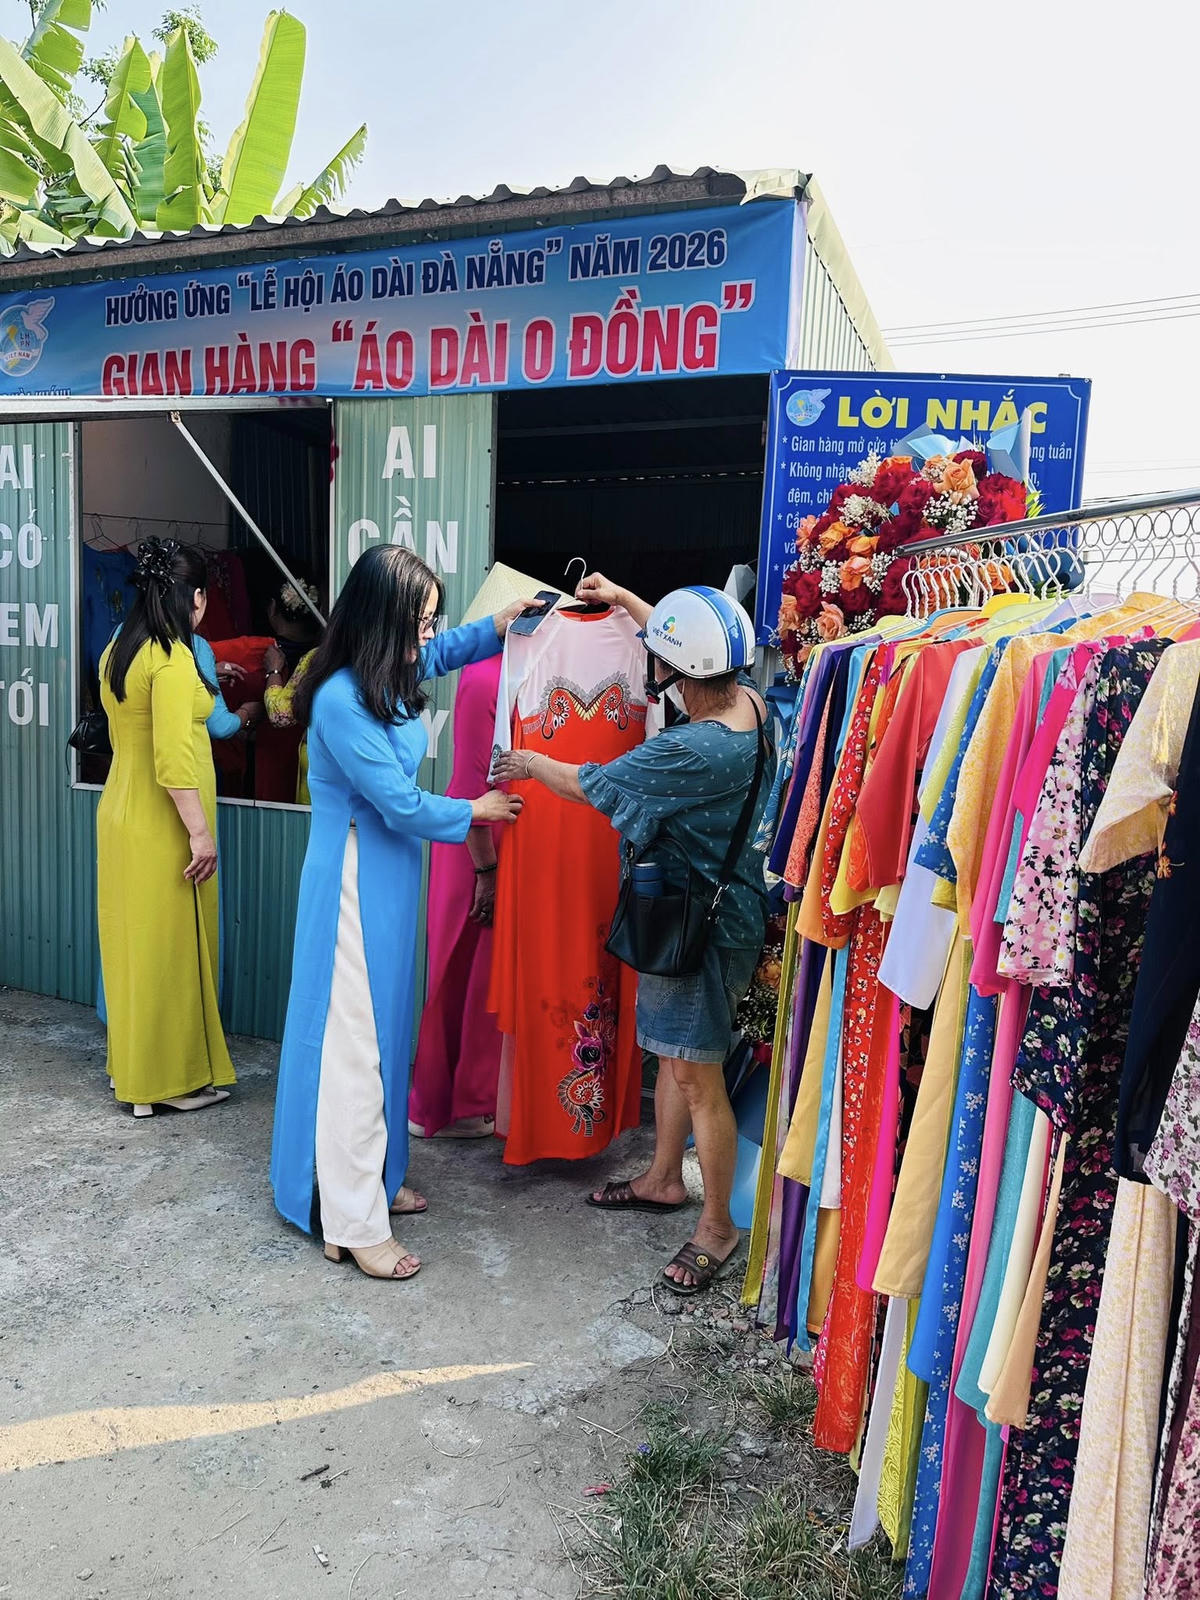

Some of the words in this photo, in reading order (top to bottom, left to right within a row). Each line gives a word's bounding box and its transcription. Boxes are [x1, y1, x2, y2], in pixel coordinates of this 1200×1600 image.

[105, 283, 179, 326] HƯỞNG
[183, 281, 231, 319] ỨNG
[283, 268, 324, 313] HỘI
[330, 264, 365, 303] ÁO
[371, 257, 415, 300] DÀI
[421, 251, 459, 295] ĐÀ
[569, 234, 641, 281] NĂM
[648, 230, 726, 272] 2026
[102, 348, 193, 396] GIAN
[204, 331, 316, 395] HÀNG
[430, 311, 508, 387] DÀI
[837, 388, 910, 429] LỜI
[926, 388, 1049, 434] NHẮC
[0, 443, 34, 490] AI
[382, 423, 438, 480] AI
[791, 435, 816, 453] Gian
[819, 437, 845, 456] hàng
[847, 435, 865, 453] mở
[867, 435, 887, 454] cửa
[1048, 441, 1073, 460] tuần
[789, 461, 823, 481] Không
[787, 487, 814, 506] đệm,
[784, 539, 797, 554] và
[663, 634, 682, 647] XANH
[0, 666, 49, 727] ỚI
